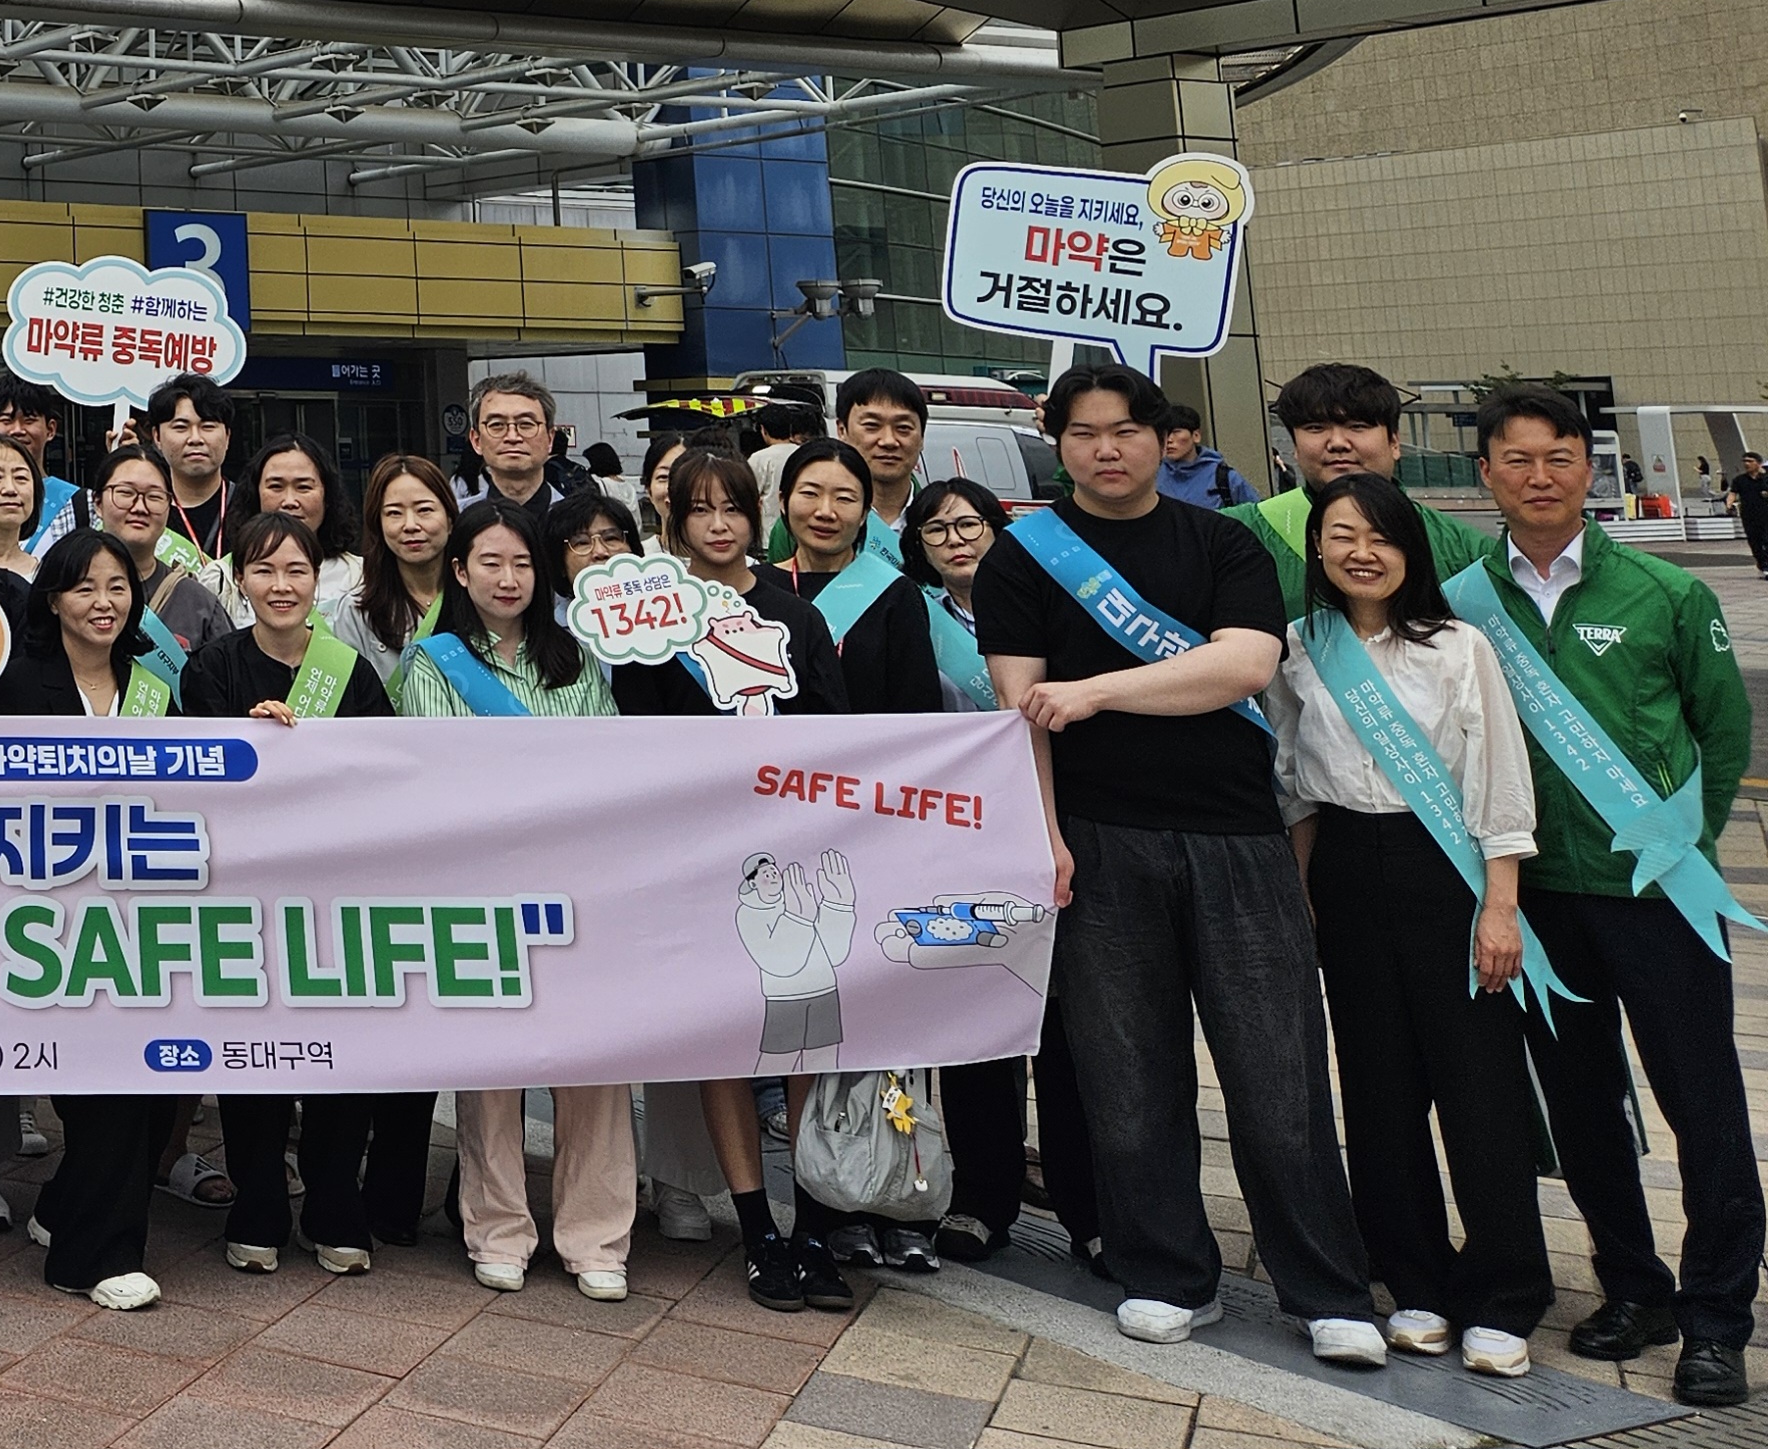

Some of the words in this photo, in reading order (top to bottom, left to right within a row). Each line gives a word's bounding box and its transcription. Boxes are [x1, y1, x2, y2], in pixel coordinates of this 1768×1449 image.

[981, 186, 1026, 213] 당신의
[1028, 192, 1075, 219] 오늘을
[1077, 198, 1144, 231] 지키세요,
[1024, 225, 1147, 276] 마약은
[42, 286, 95, 312] #건강한
[98, 291, 125, 315] 청춘
[131, 295, 208, 322] #함께하는
[976, 270, 1183, 331] 거절하세요.
[27, 317, 105, 363] 마약류
[112, 323, 218, 375] 중독예방
[371, 364, 381, 379] 곳
[594, 583, 623, 601] 마약류
[623, 579, 644, 596] 중독
[643, 574, 672, 592] 상담은
[590, 592, 688, 639] 1342!
[1096, 587, 1191, 659] 대구과
[1577, 625, 1622, 644] TERRA
[1359, 679, 1393, 722] 마약류
[1388, 721, 1417, 750] 중독
[1411, 751, 1440, 780] 혼자
[1487, 613, 1518, 653] 마약류
[1514, 651, 1540, 679] 중독
[1536, 678, 1563, 708] 혼자
[1558, 708, 1612, 764] 고민하지
[1605, 764, 1649, 809] 마세요
[166, 744, 227, 777] 기념
[1344, 687, 1379, 729] 당신의
[1372, 729, 1423, 785] 일상사이
[1420, 790, 1462, 845] 1342
[1543, 719, 1591, 772] 1342
[753, 764, 861, 810] SAFE
[874, 781, 983, 830] LIFE!
[3, 904, 260, 999] SAFE
[283, 902, 564, 999] LIFE!"
[13, 1041, 60, 1071] 2시
[158, 1045, 201, 1069] 장소
[221, 1040, 335, 1072] 동대구역
